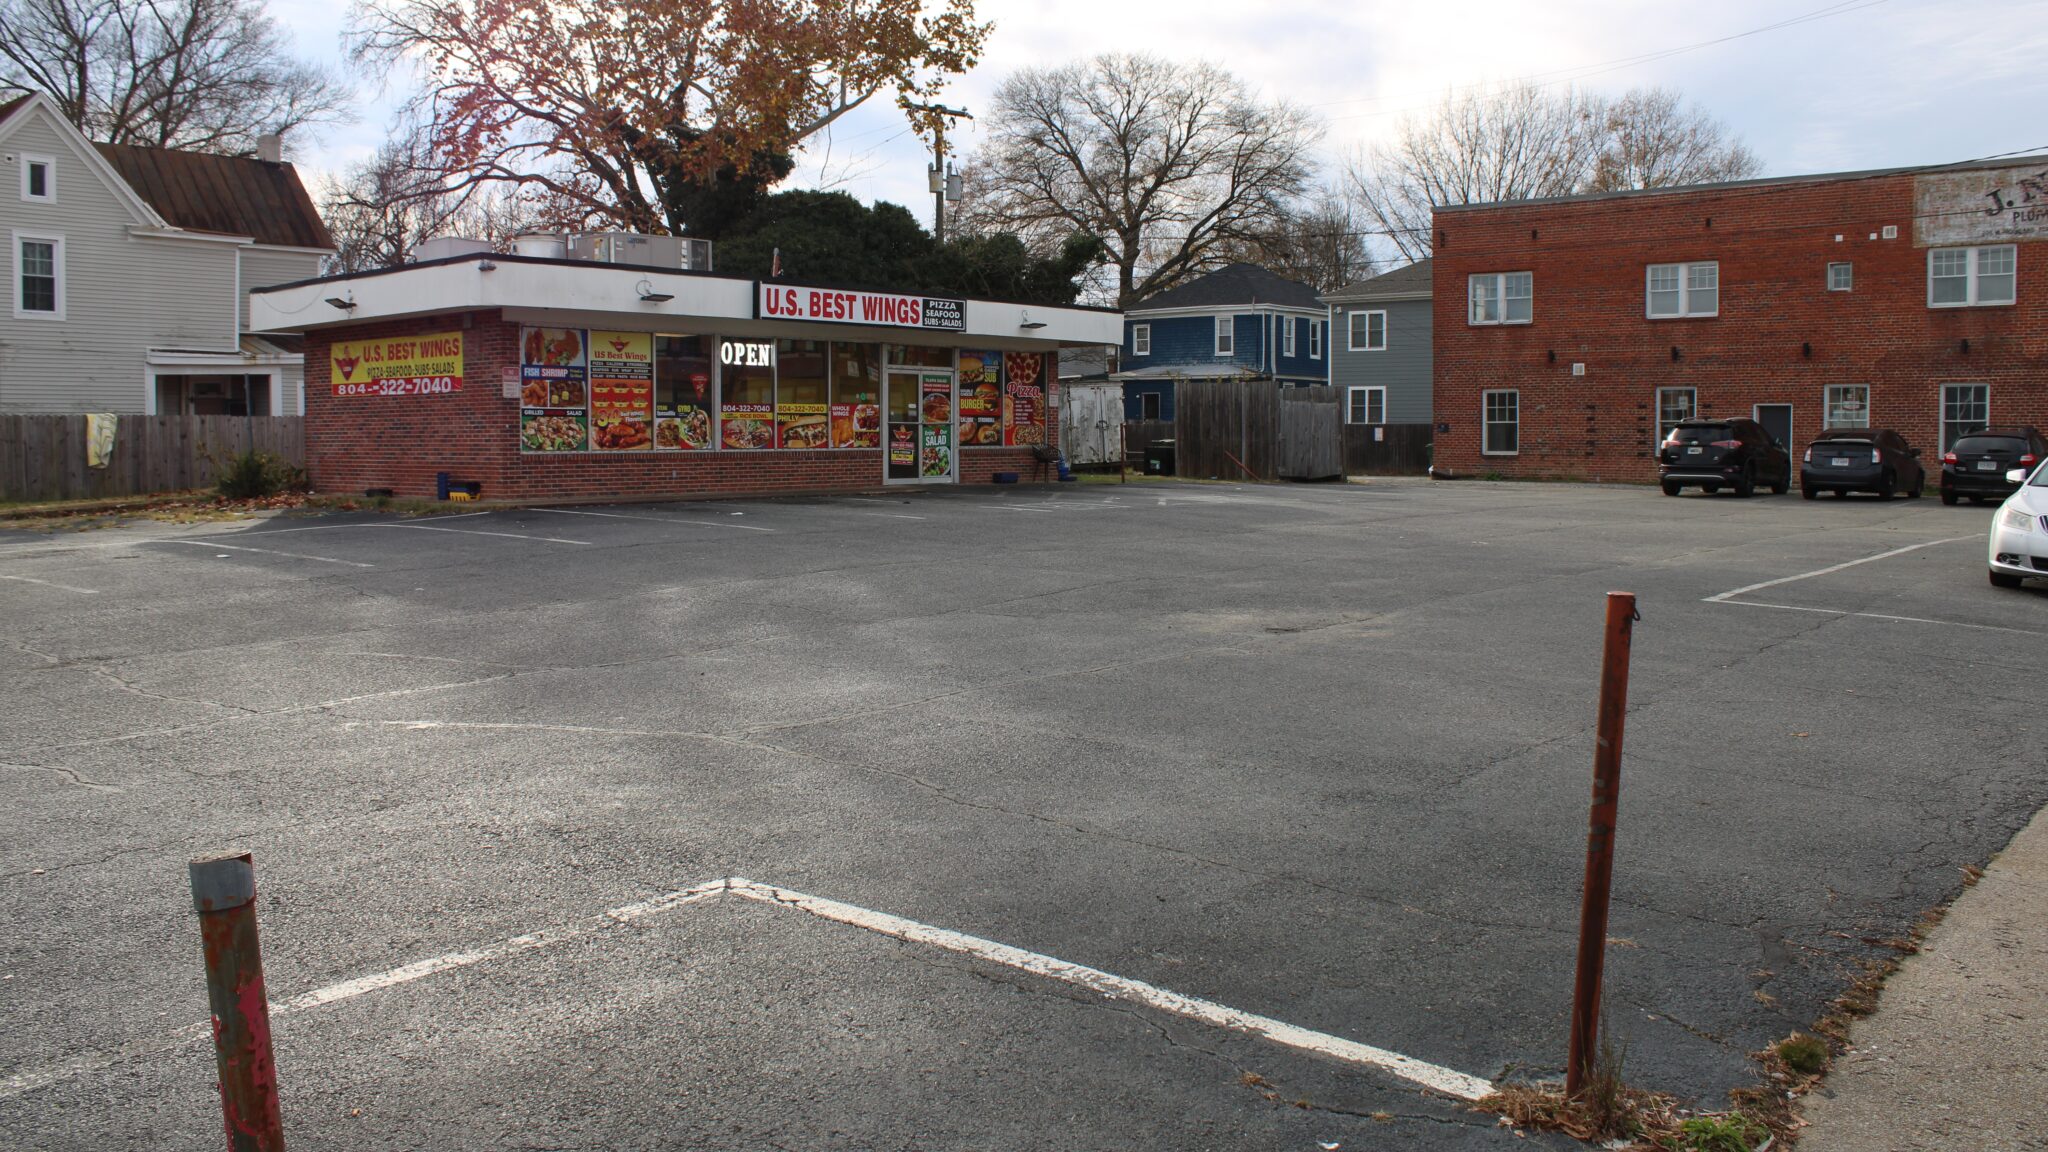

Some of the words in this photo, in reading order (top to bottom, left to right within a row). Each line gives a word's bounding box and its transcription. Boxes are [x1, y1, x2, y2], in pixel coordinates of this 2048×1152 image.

[766, 288, 803, 316] U.S.
[809, 291, 857, 320] BEST
[862, 296, 920, 325] WINGS
[929, 301, 957, 310] PIZZA
[926, 310, 960, 319] SEAFOOD
[363, 344, 384, 363] U.S.
[387, 341, 417, 361] BEST
[420, 338, 460, 358] WINGS
[594, 351, 605, 359] US
[607, 351, 624, 359] Best
[625, 352, 648, 361] Wings
[721, 342, 771, 367] OPEN
[524, 367, 540, 377] FISH
[541, 368, 568, 378] SHRIMP
[984, 372, 997, 383] SUB
[1007, 382, 1041, 398] Pizza
[960, 399, 984, 409] BURGER
[925, 435, 947, 446] SALAD
